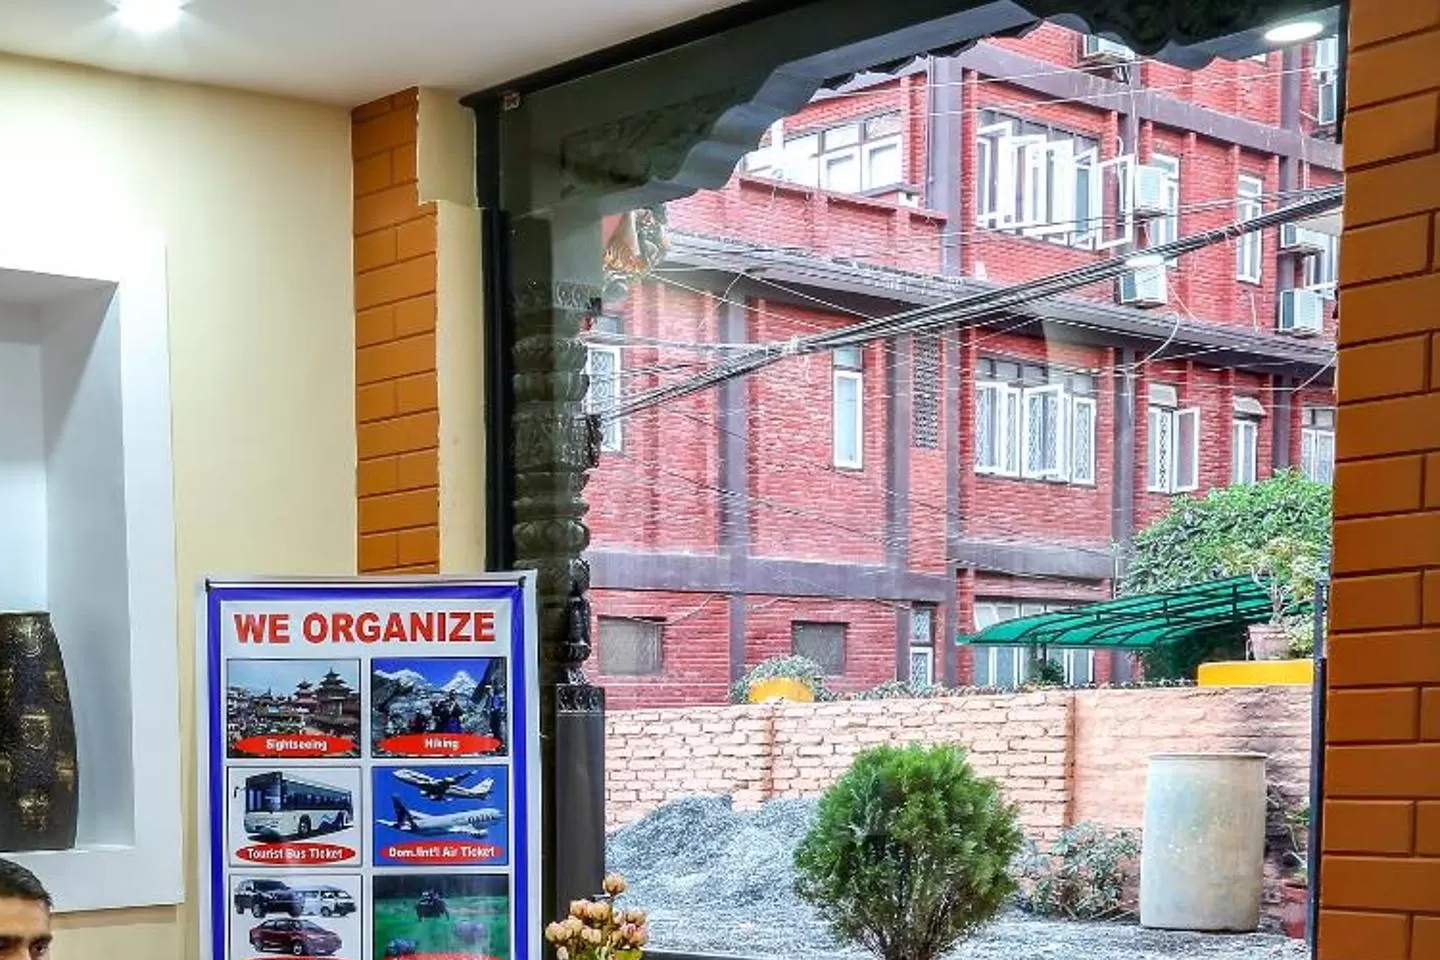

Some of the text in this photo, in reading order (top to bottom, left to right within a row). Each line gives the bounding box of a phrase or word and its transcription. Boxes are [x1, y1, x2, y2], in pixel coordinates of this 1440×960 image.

[233, 611, 496, 644] WE ORGANIZE
[266, 738, 328, 751] Sightseeing
[424, 738, 460, 750] Hiking
[247, 848, 343, 859] Tourist Bus Ticket
[442, 846, 458, 857] Air
[461, 846, 495, 857] Ticket
